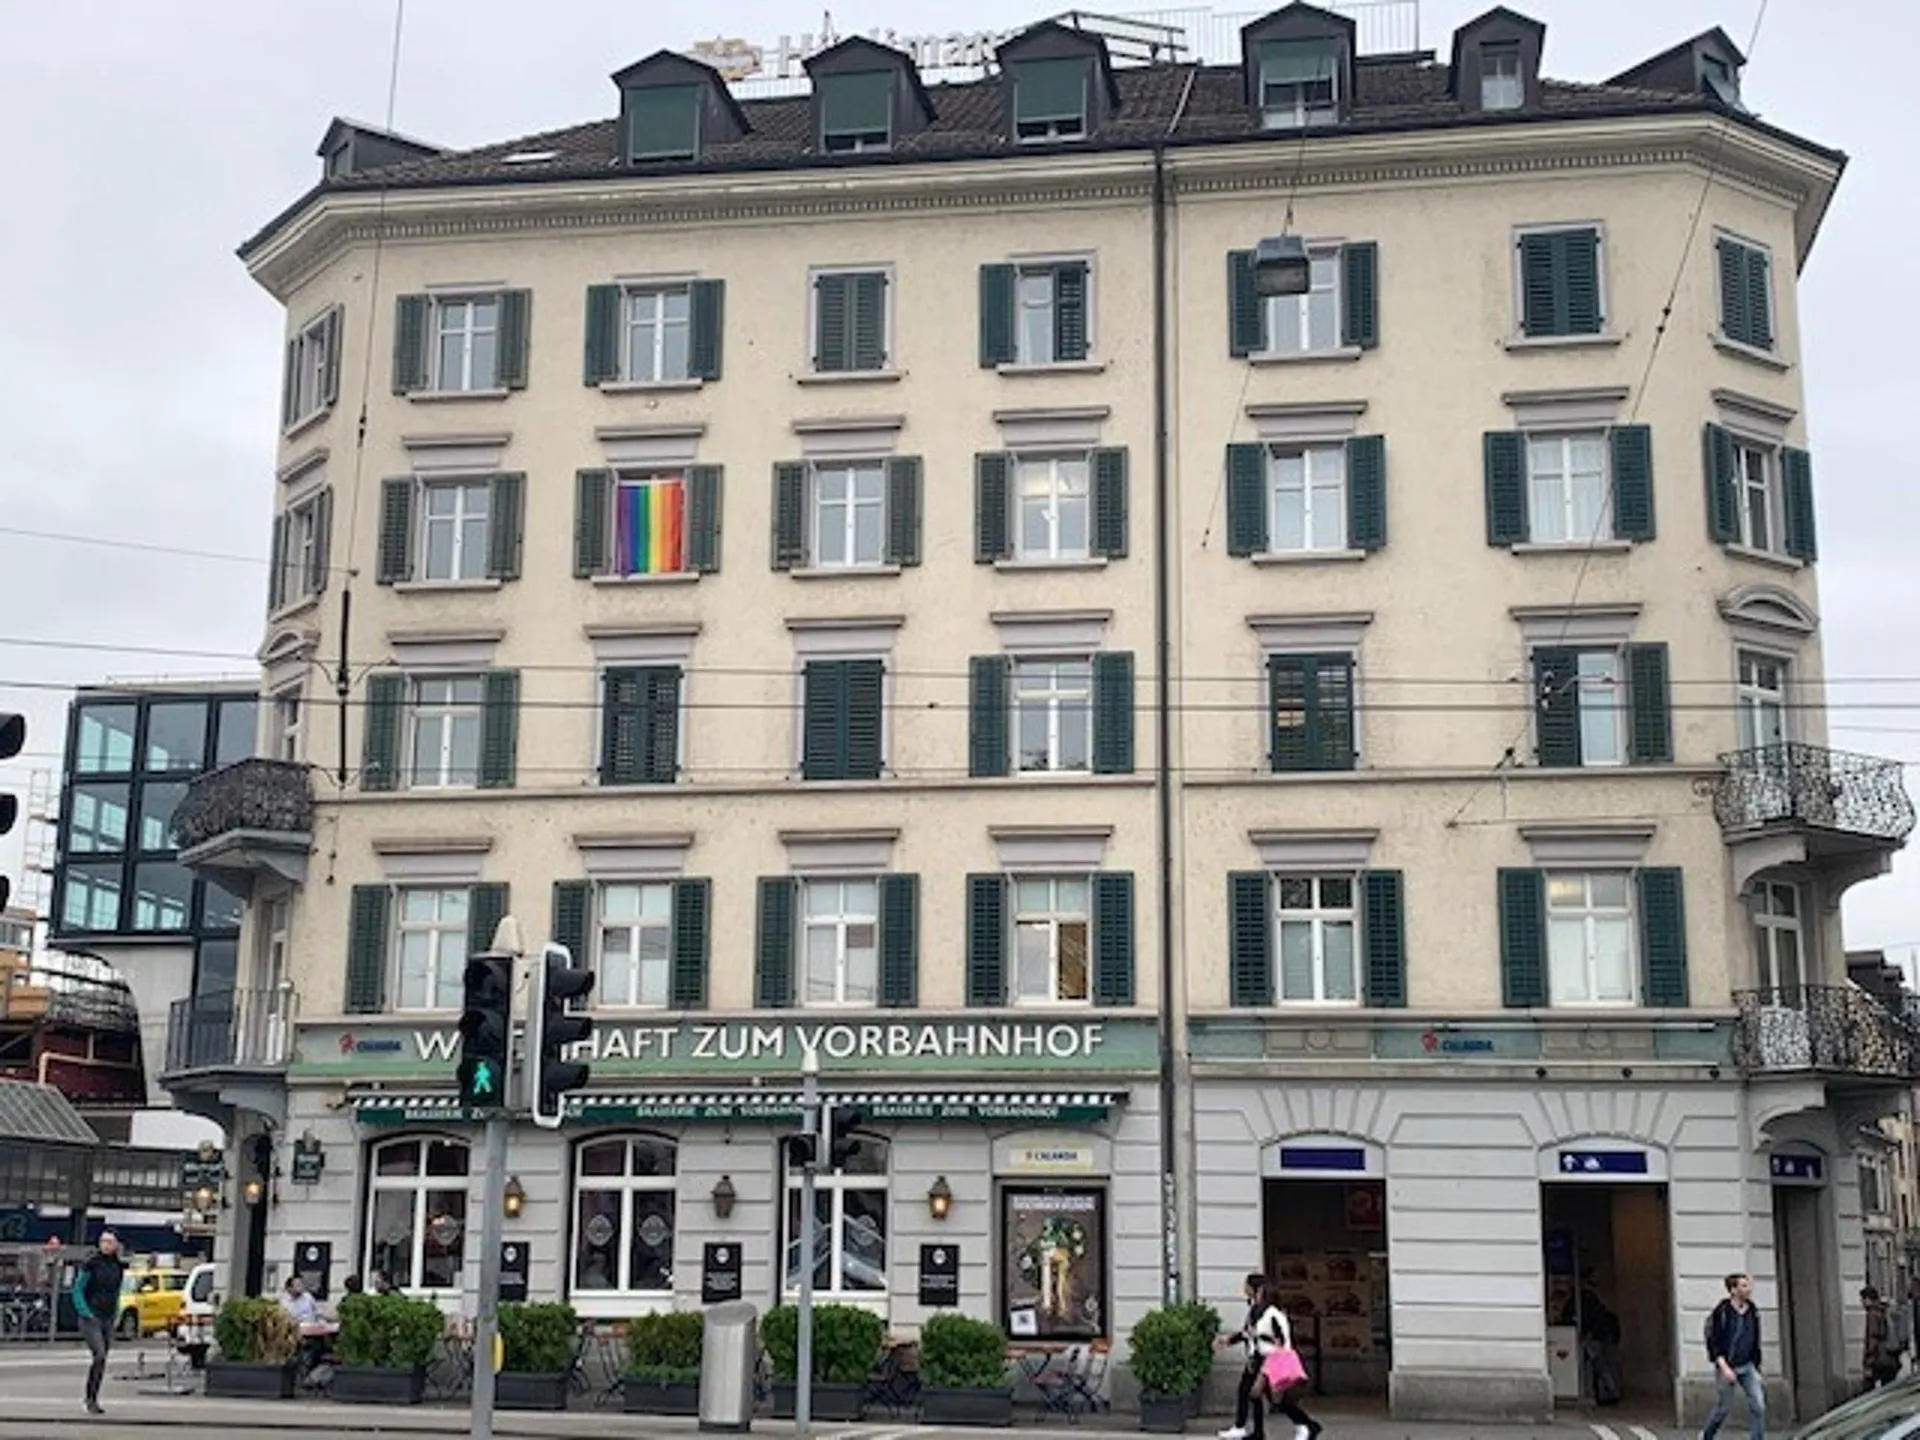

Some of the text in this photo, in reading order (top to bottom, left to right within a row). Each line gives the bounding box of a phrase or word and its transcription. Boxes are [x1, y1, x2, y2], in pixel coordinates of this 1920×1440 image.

[414, 1024, 1103, 1062] WHAFT ZUM VORBAHNHOF
